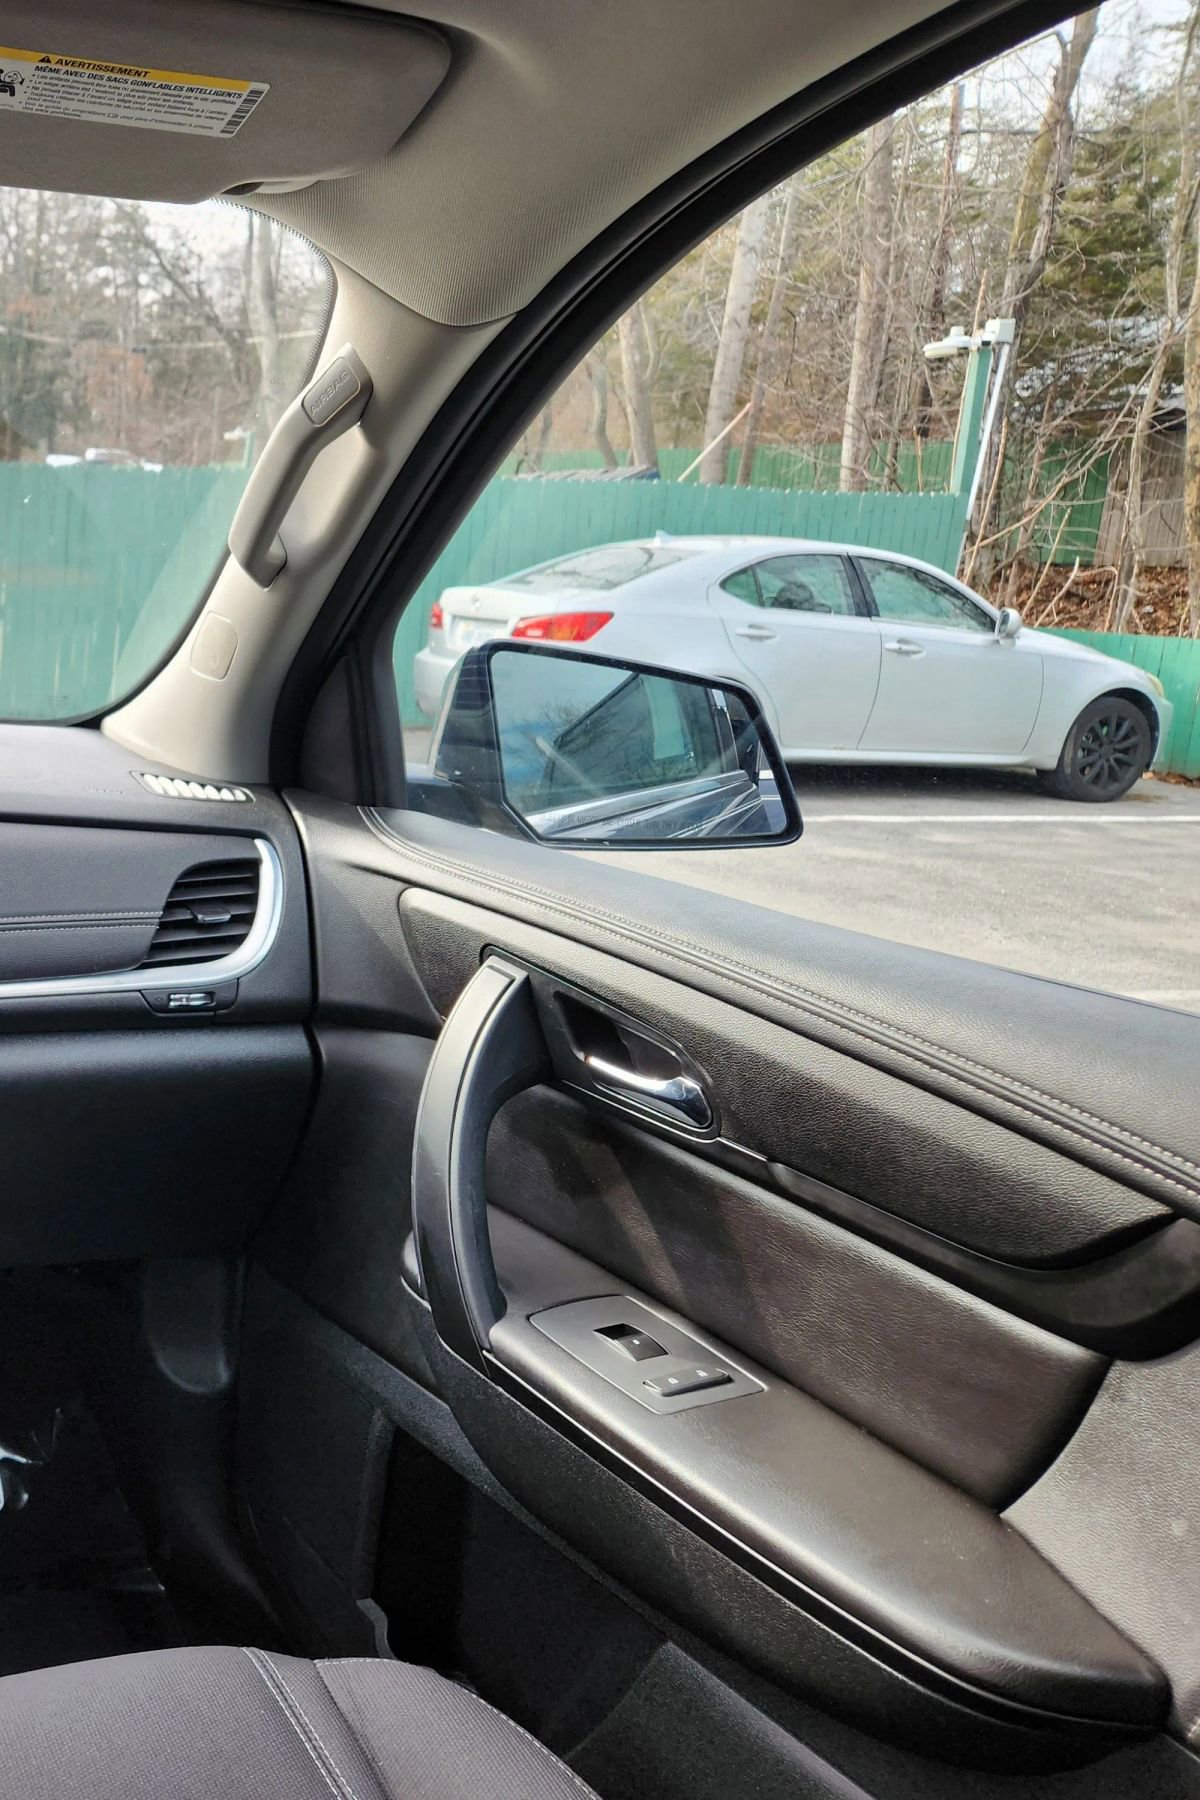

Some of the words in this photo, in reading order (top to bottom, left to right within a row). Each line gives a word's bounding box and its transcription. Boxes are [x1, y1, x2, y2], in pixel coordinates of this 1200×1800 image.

[34, 65, 63, 75] MÊME
[62, 70, 86, 79] AVEC
[87, 72, 105, 81] DES
[105, 75, 130, 85] SACS
[130, 79, 186, 92] GONFLABLES
[185, 86, 243, 99] INTELLIGENTS
[54, 57, 151, 79] AVERTISSEMENT
[309, 369, 350, 417] AIRBAG
